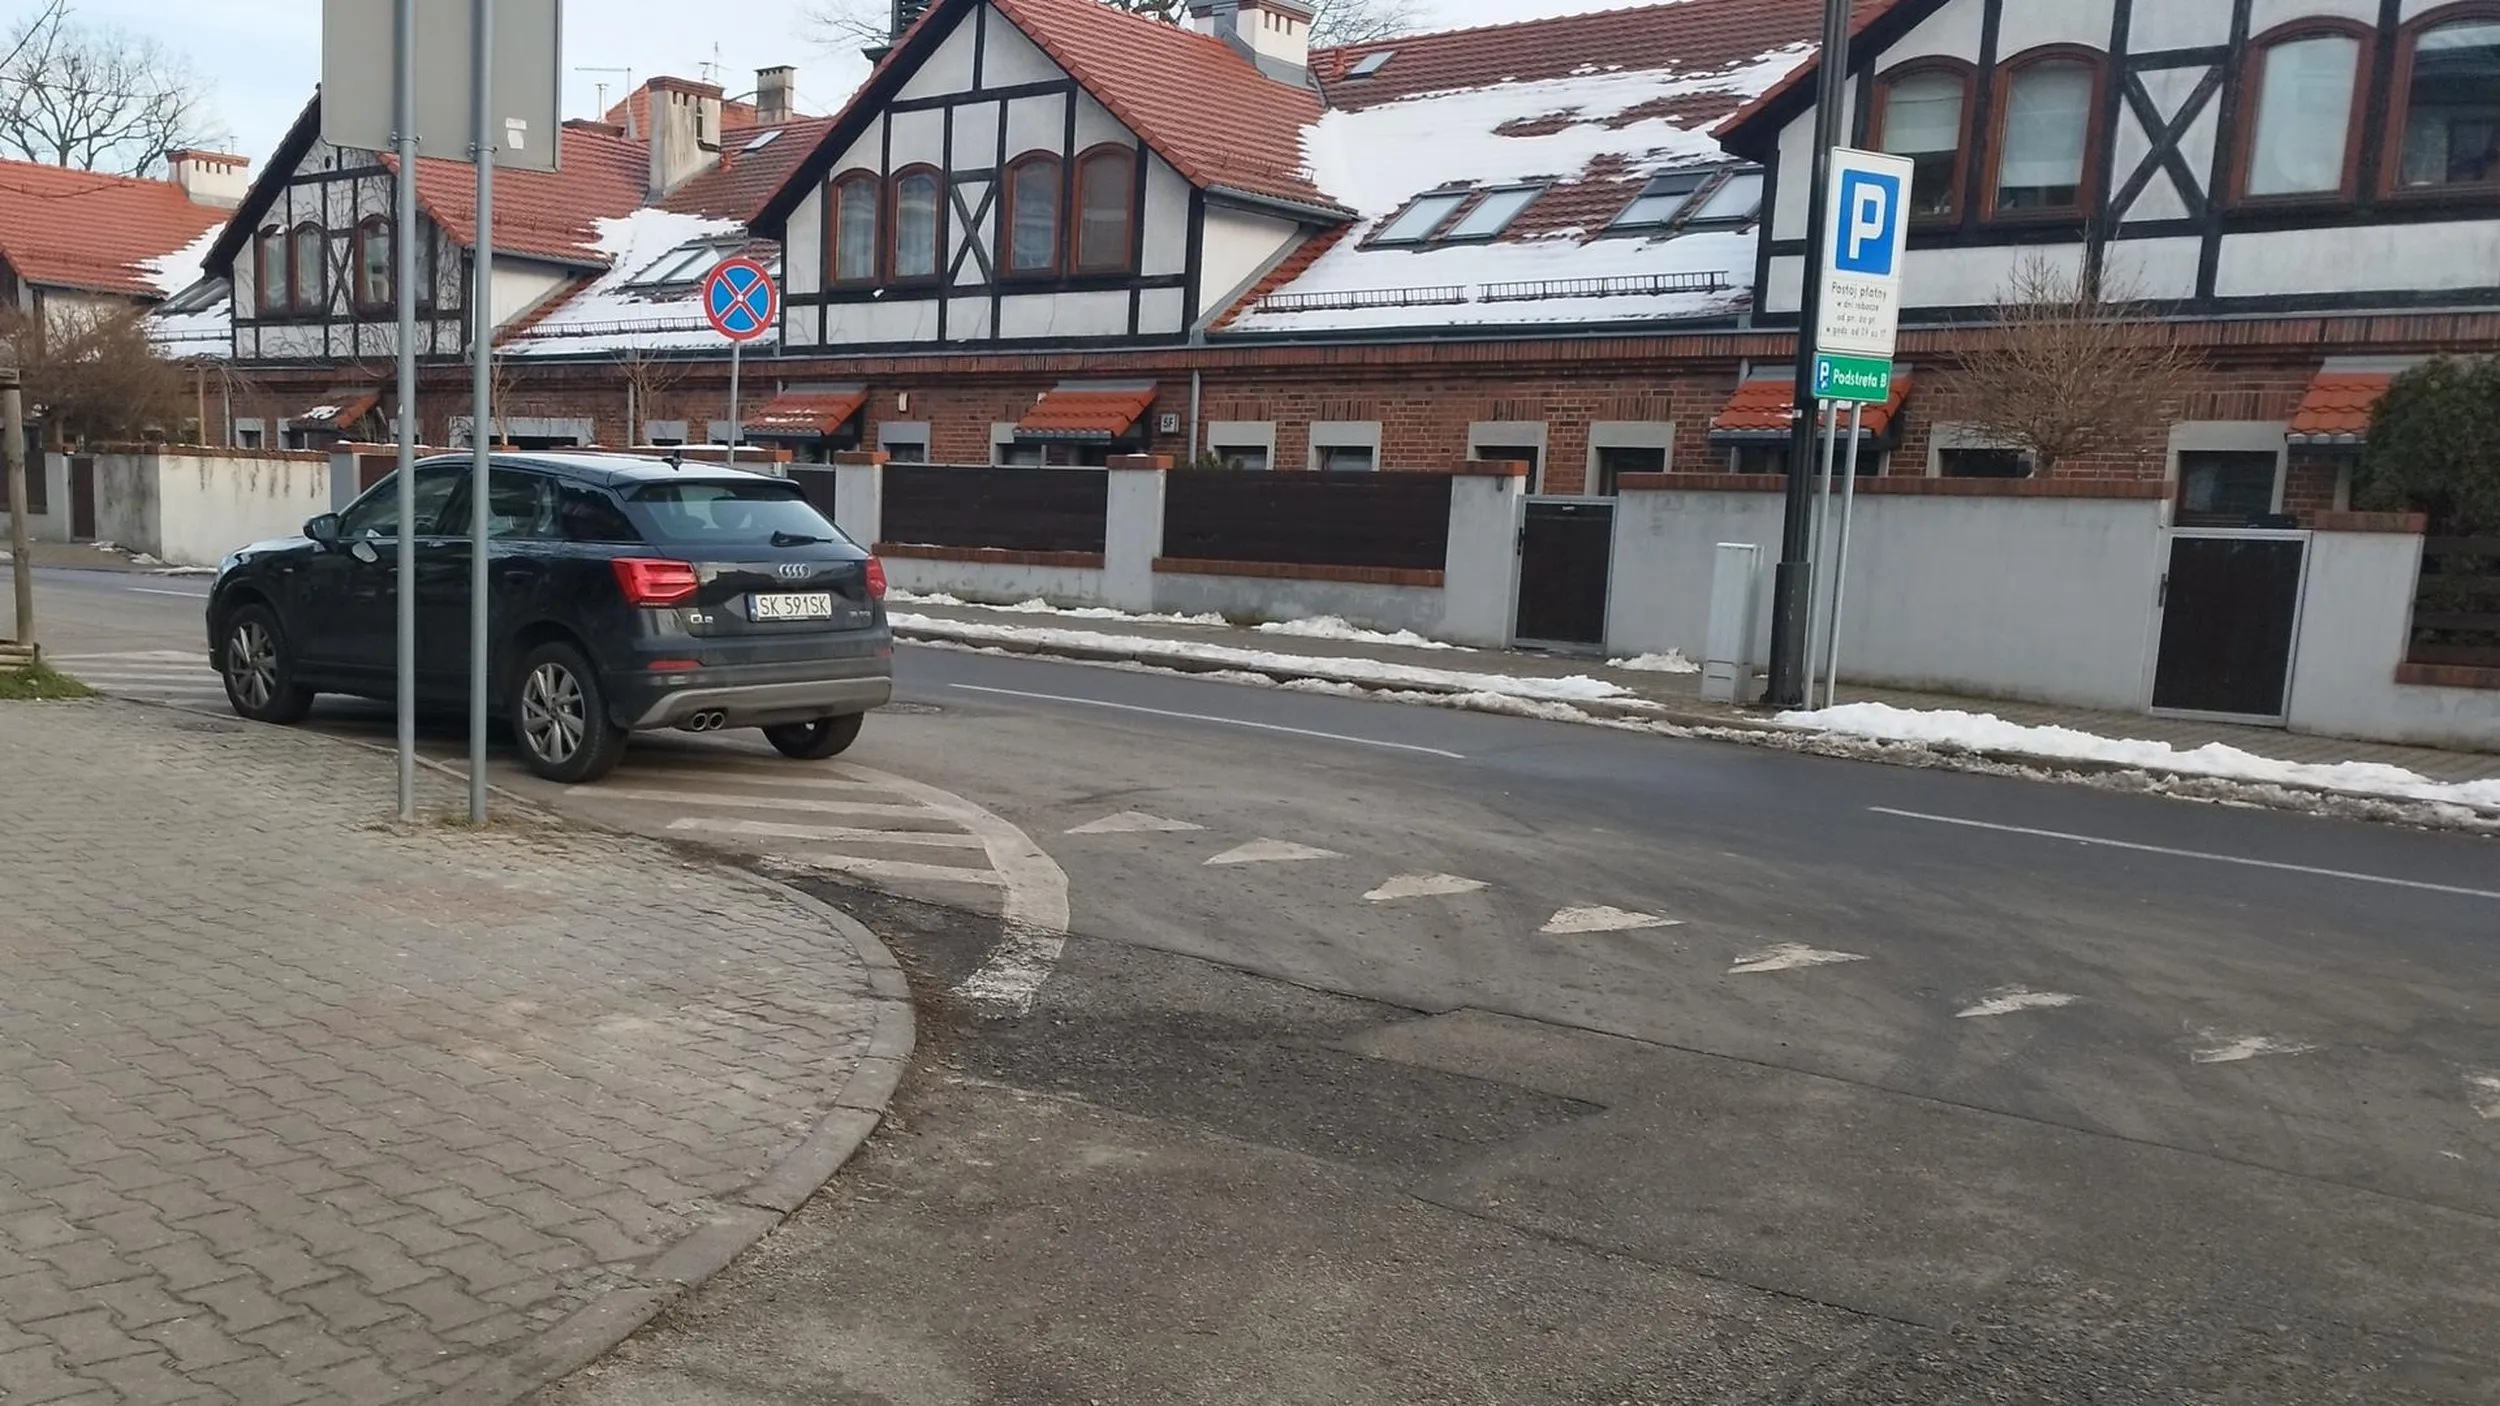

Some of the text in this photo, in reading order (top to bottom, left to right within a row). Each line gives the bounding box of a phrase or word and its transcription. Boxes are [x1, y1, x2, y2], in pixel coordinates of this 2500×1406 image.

[1849, 182, 1886, 259] P
[1833, 368, 1888, 388] Podstrefa B
[759, 595, 829, 615] SK 591SK
